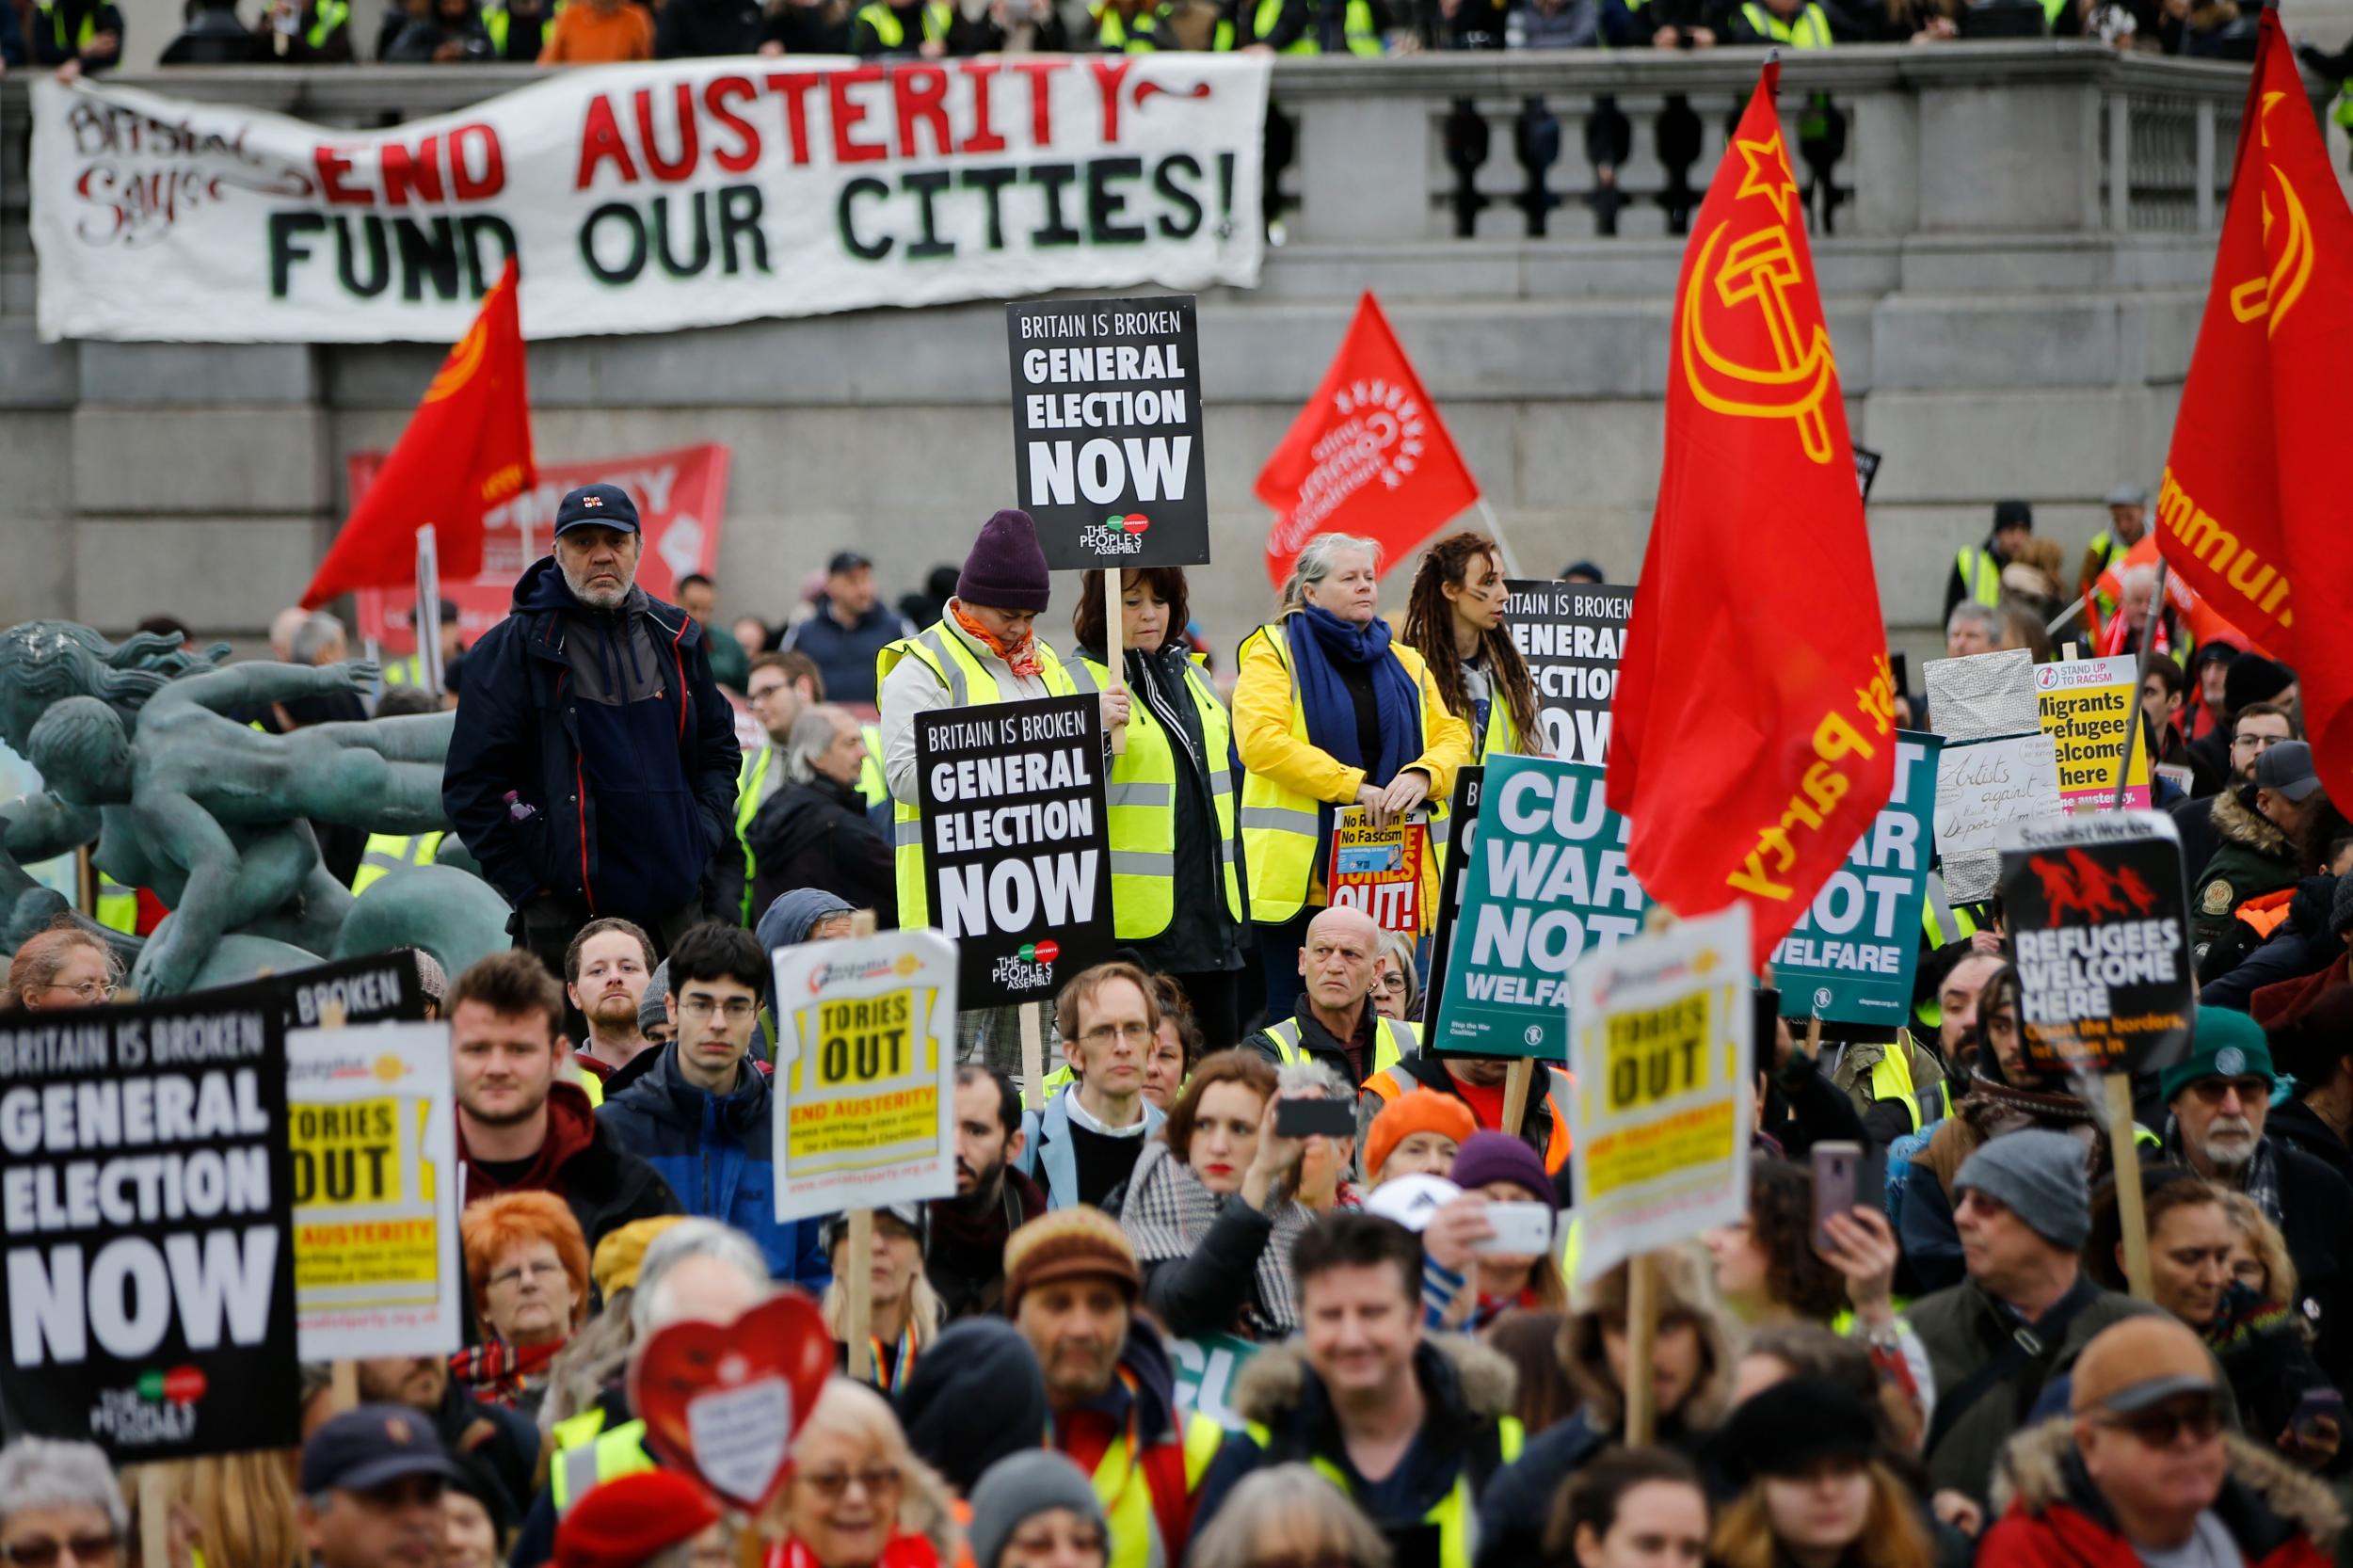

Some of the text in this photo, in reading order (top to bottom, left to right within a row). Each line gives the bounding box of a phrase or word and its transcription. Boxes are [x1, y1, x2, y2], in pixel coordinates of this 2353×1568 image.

[315, 56, 1135, 207] END AUSTERITY
[268, 152, 1237, 303] FUND OUR CITIES!
[1021, 311, 1181, 338] BRITAIN IS BROKEN
[1023, 344, 1185, 384] GENERAL
[1026, 389, 1186, 429] ELECTION
[1028, 436, 1193, 506] NOW
[1084, 525, 1108, 536] THE
[1094, 545, 1142, 555] ASSEMBLY
[1502, 593, 1633, 619] ITAIN IS BROKEN
[2061, 663, 2106, 675] STAND UP
[2061, 673, 2112, 686] TO RACISM
[928, 710, 1085, 753] BRITAIN IS BROKEN
[1939, 753, 2009, 787] Artists
[2056, 742, 2126, 763] elcome
[930, 747, 1091, 802] GENERAL
[1981, 776, 2037, 810] against
[2059, 767, 2107, 787] here
[935, 797, 1093, 854] ELECTION
[1341, 831, 1354, 843] No
[1358, 830, 1401, 842] Fascism
[1343, 815, 1356, 828] No
[937, 849, 1098, 939] NOW
[1486, 838, 1644, 911] WAR
[1470, 904, 1638, 973] NOT
[2015, 919, 2181, 964] REFUGEES
[997, 955, 1020, 968] THE
[2017, 951, 2178, 990] WELCOME
[298, 969, 401, 1022] BROKEN
[1006, 974, 1052, 990] ASSEMBLY
[822, 995, 908, 1032] TORIES
[2021, 985, 2110, 1024] HERE
[0, 1012, 264, 1080] BRITAIN IS BROKEN
[824, 1030, 906, 1083] OUT
[1612, 1038, 1700, 1111] OUT
[0, 1067, 270, 1156] GENERAL
[288, 1103, 392, 1142] ORIES
[790, 1085, 936, 1126] END AUSTERITY
[3, 1144, 270, 1238] ELECTION
[300, 1219, 433, 1247] AUSTERITY
[6, 1224, 280, 1369] NOW
